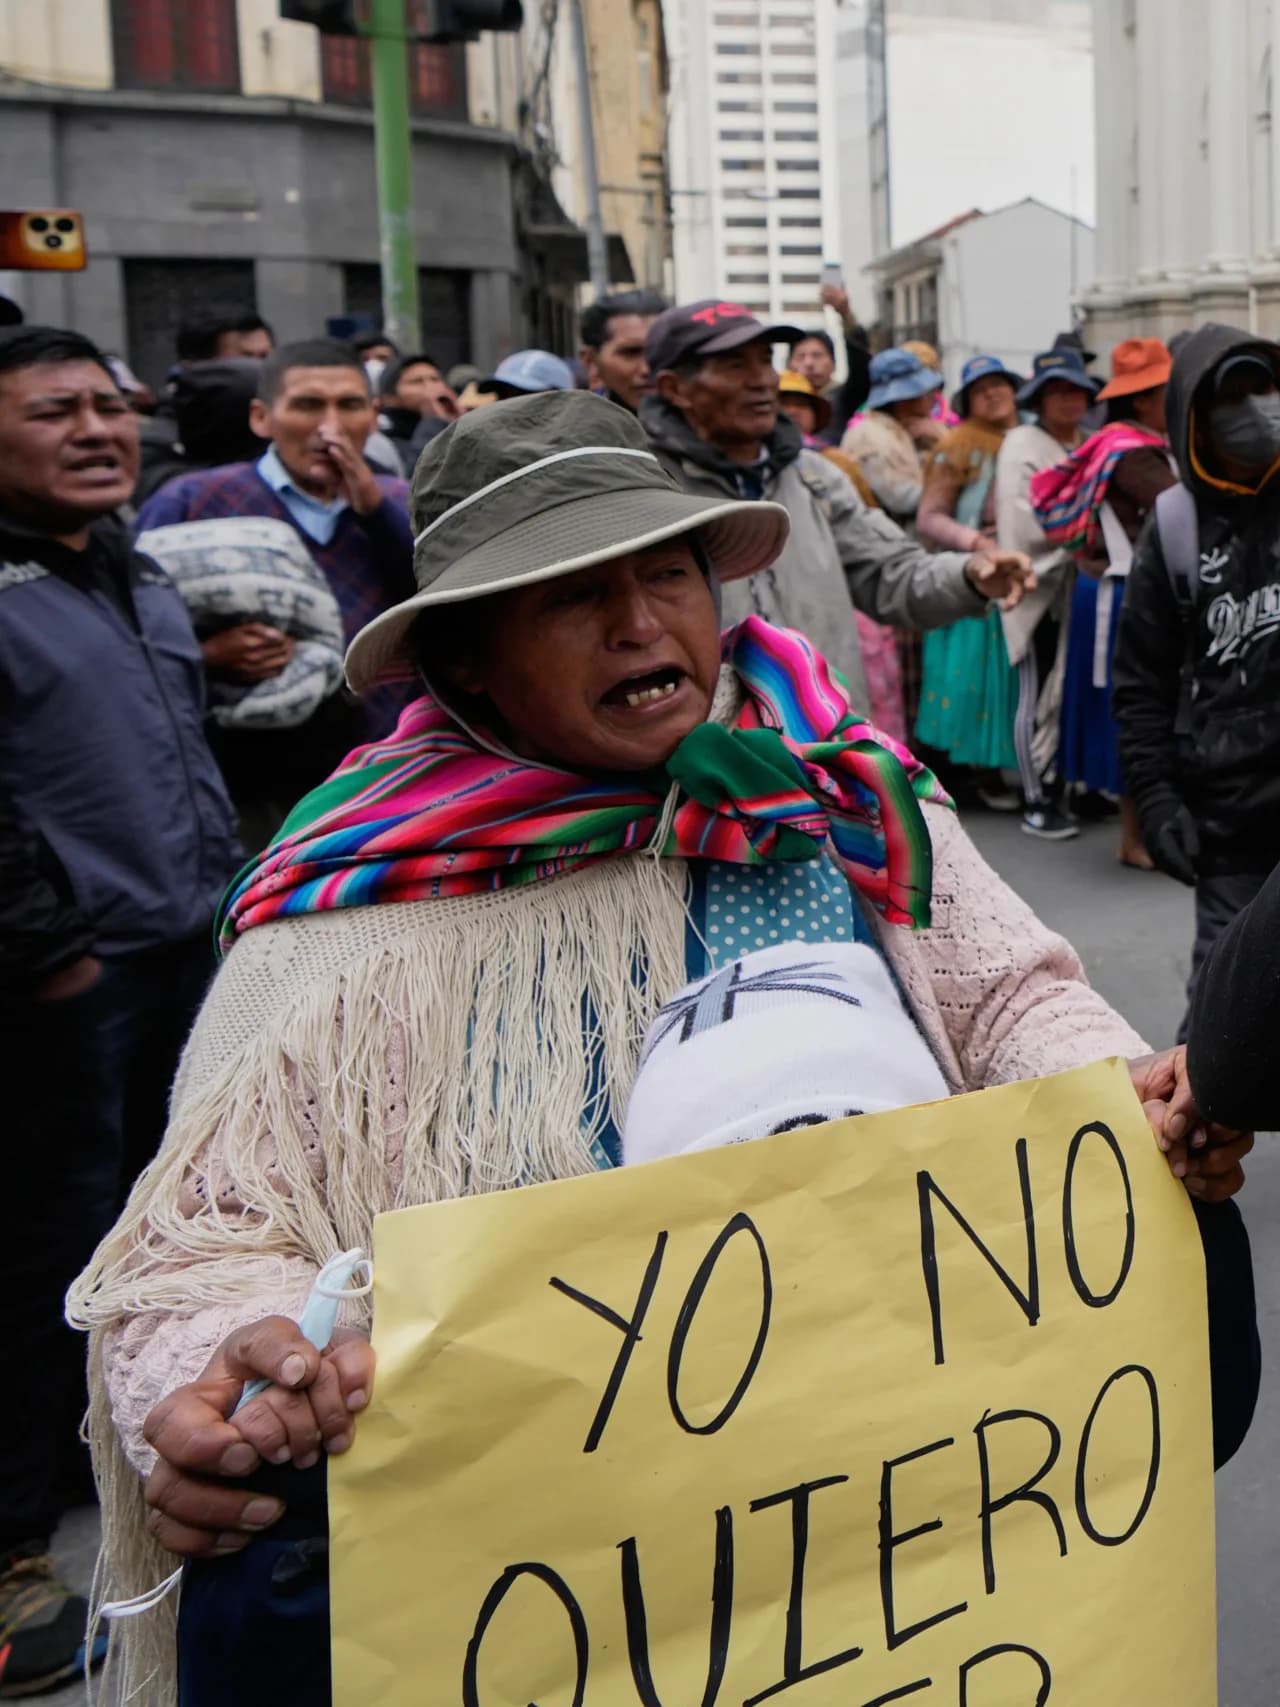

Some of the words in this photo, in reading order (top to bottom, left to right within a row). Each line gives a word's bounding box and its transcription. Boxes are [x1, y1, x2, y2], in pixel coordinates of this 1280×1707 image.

[549, 1211, 774, 1453] YO
[916, 1120, 1135, 1366] NO
[462, 1363, 1161, 1707] QUIERO
